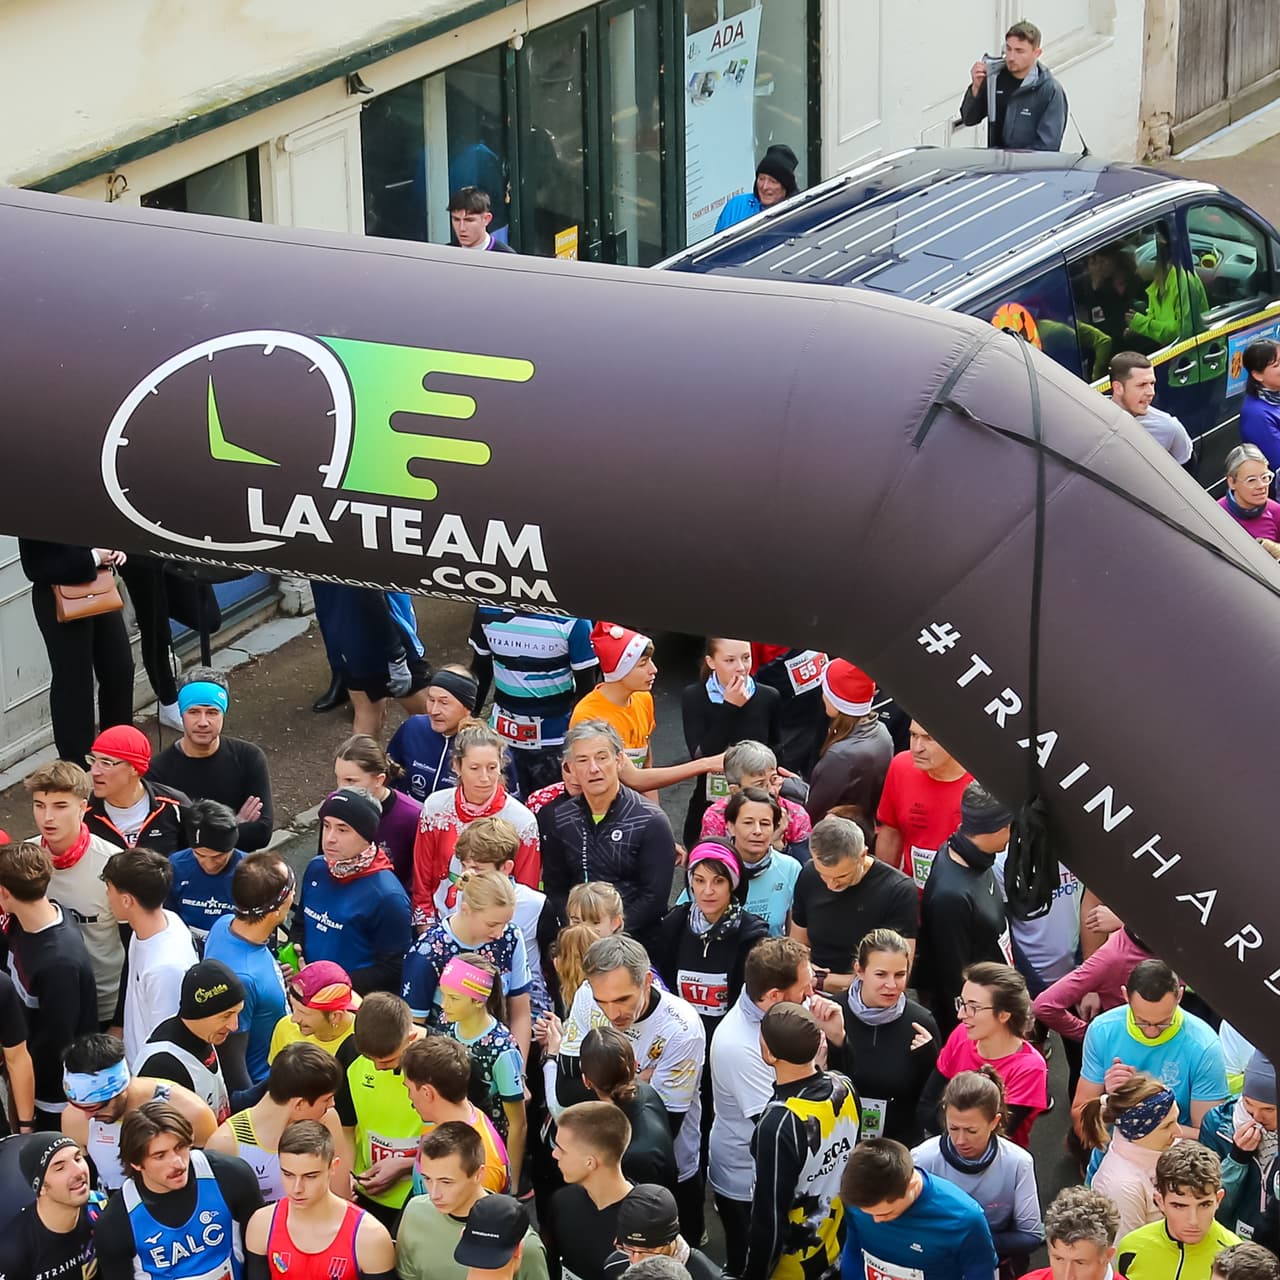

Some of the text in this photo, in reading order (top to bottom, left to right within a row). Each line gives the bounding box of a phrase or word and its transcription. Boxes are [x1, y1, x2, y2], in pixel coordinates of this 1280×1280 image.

[710, 21, 744, 52] ADA
[246, 487, 549, 572] LA'TEAM
[420, 566, 558, 604] .COM
[800, 662, 817, 680] 55
[503, 720, 518, 737] 16
[689, 985, 709, 1001] 17
[822, 1137, 851, 1165] ECA
[150, 1223, 225, 1269] EALC
